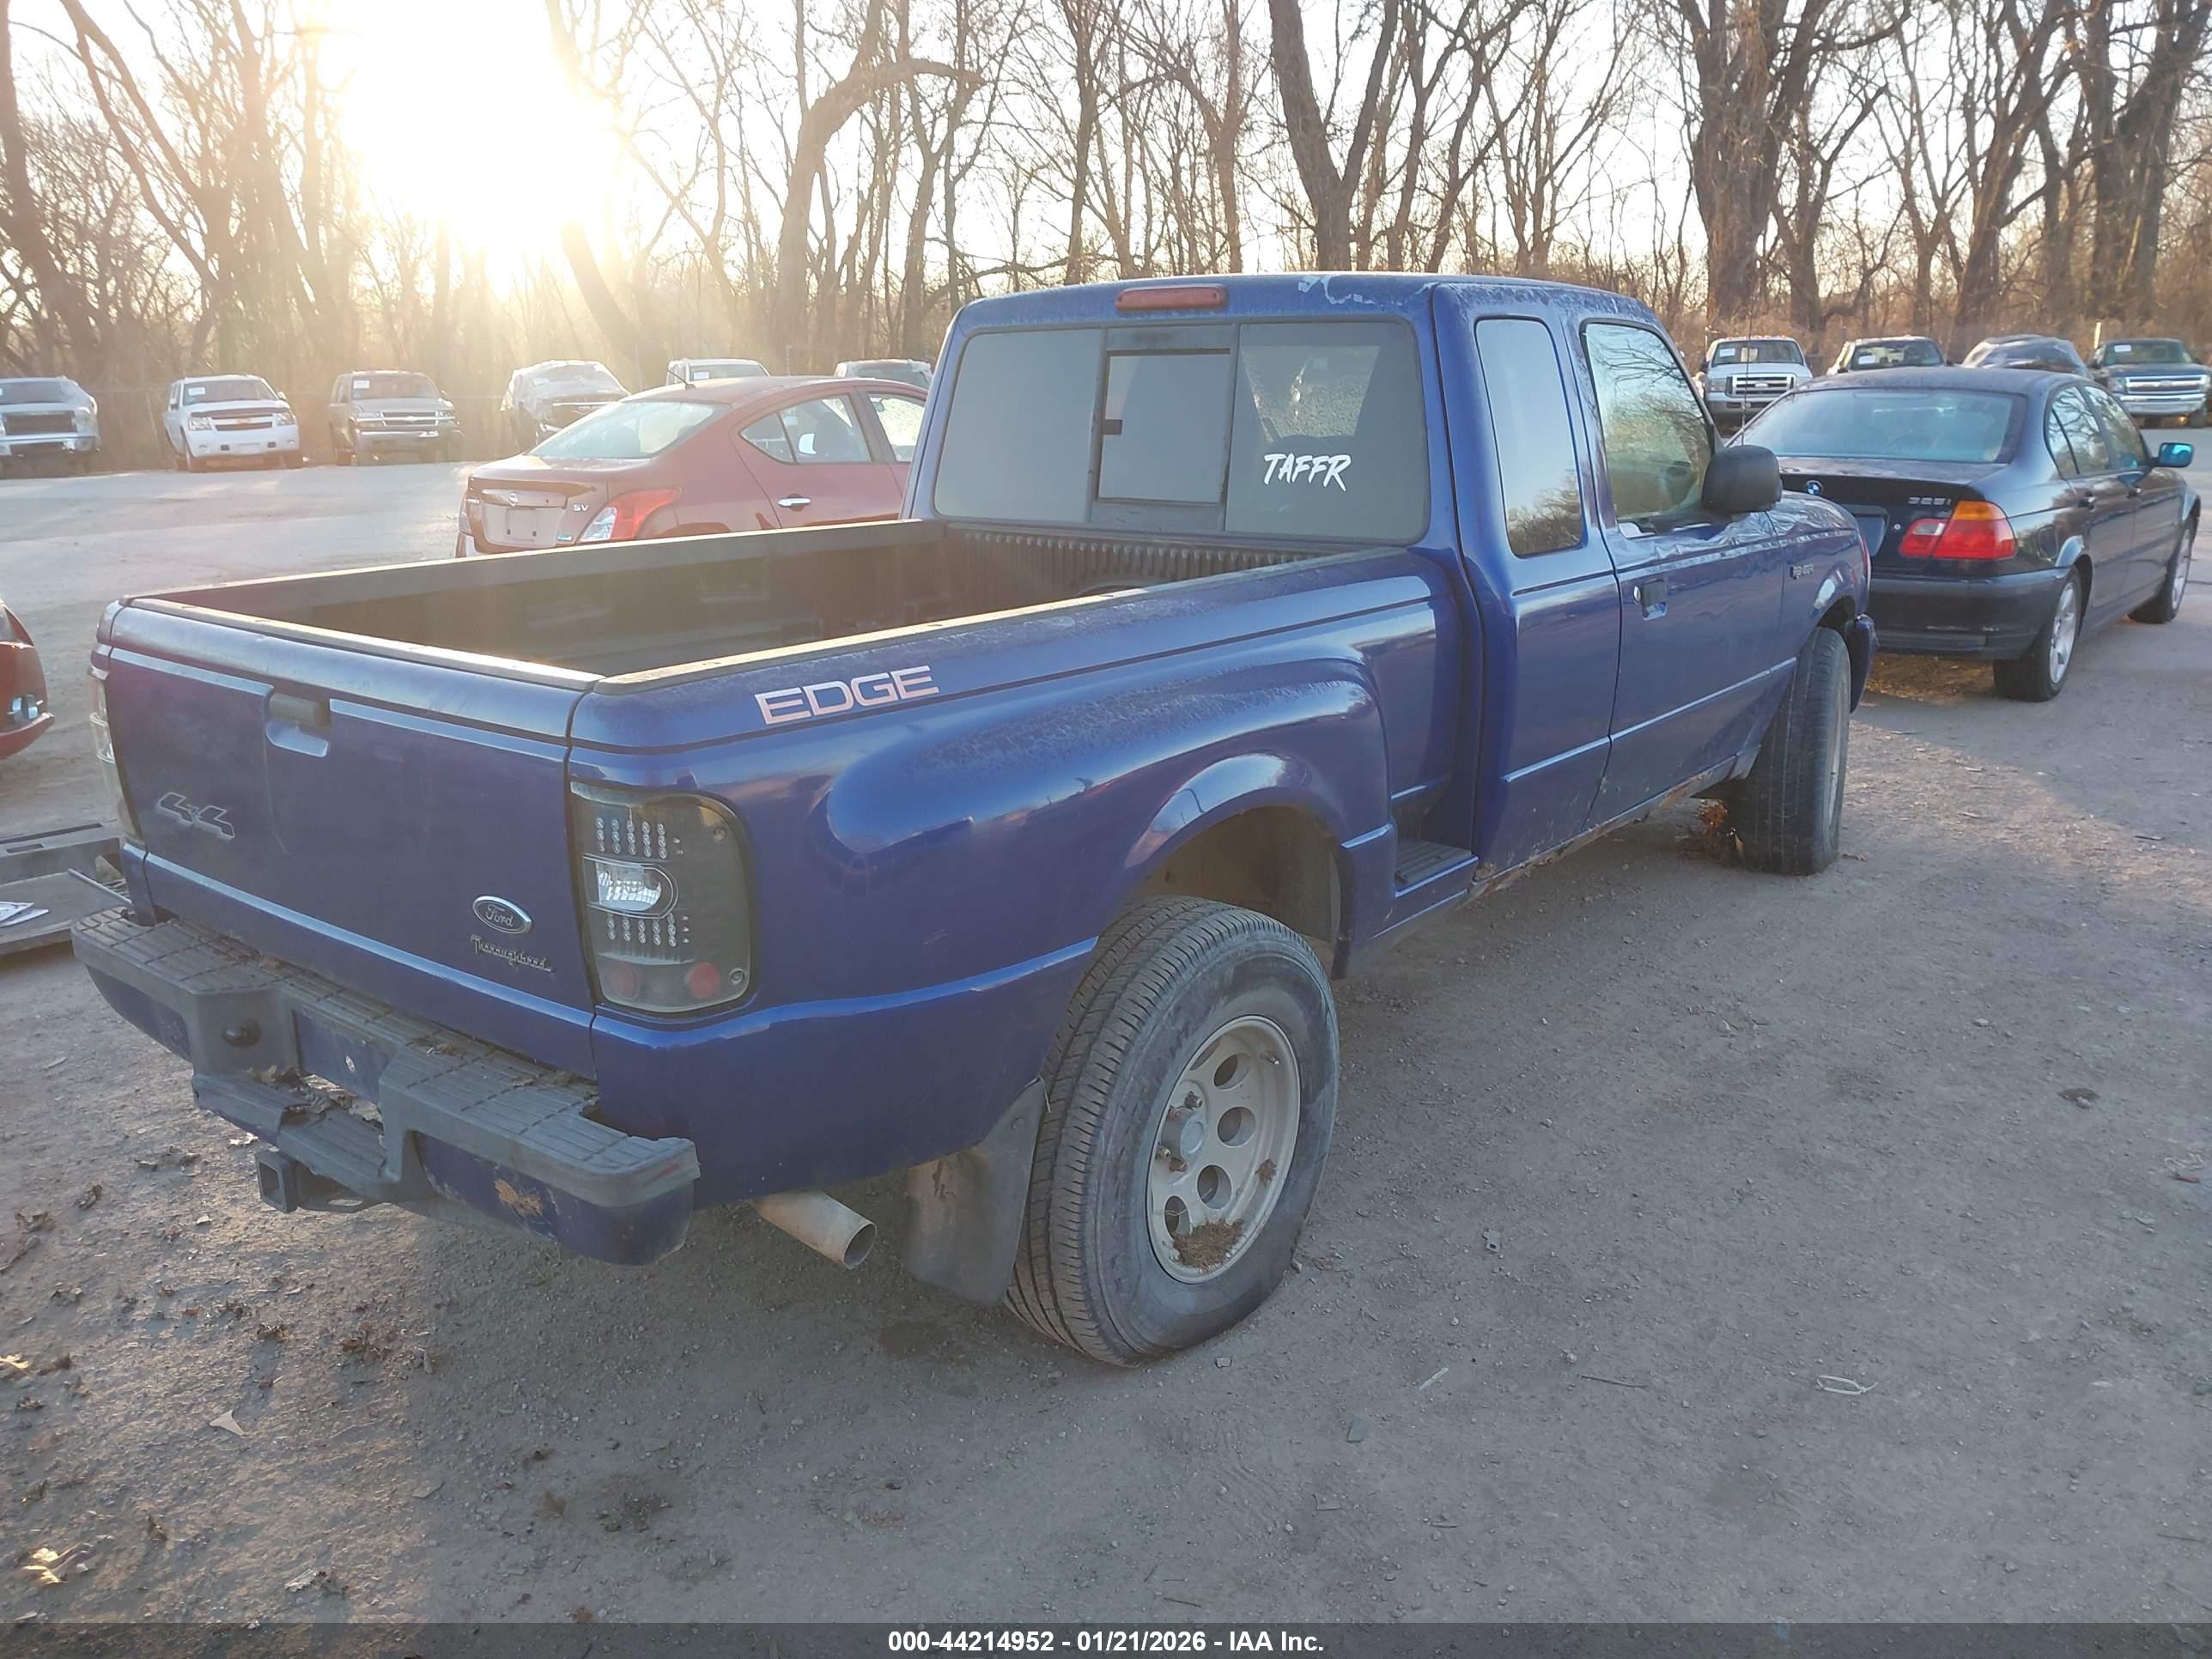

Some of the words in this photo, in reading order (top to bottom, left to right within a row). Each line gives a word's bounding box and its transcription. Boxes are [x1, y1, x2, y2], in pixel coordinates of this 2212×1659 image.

[1264, 453, 1352, 492] TAFFR
[573, 503, 589, 513] SV
[754, 665, 940, 726] EDGE
[485, 903, 515, 927] Ford
[470, 934, 552, 972] Thoroughbred
